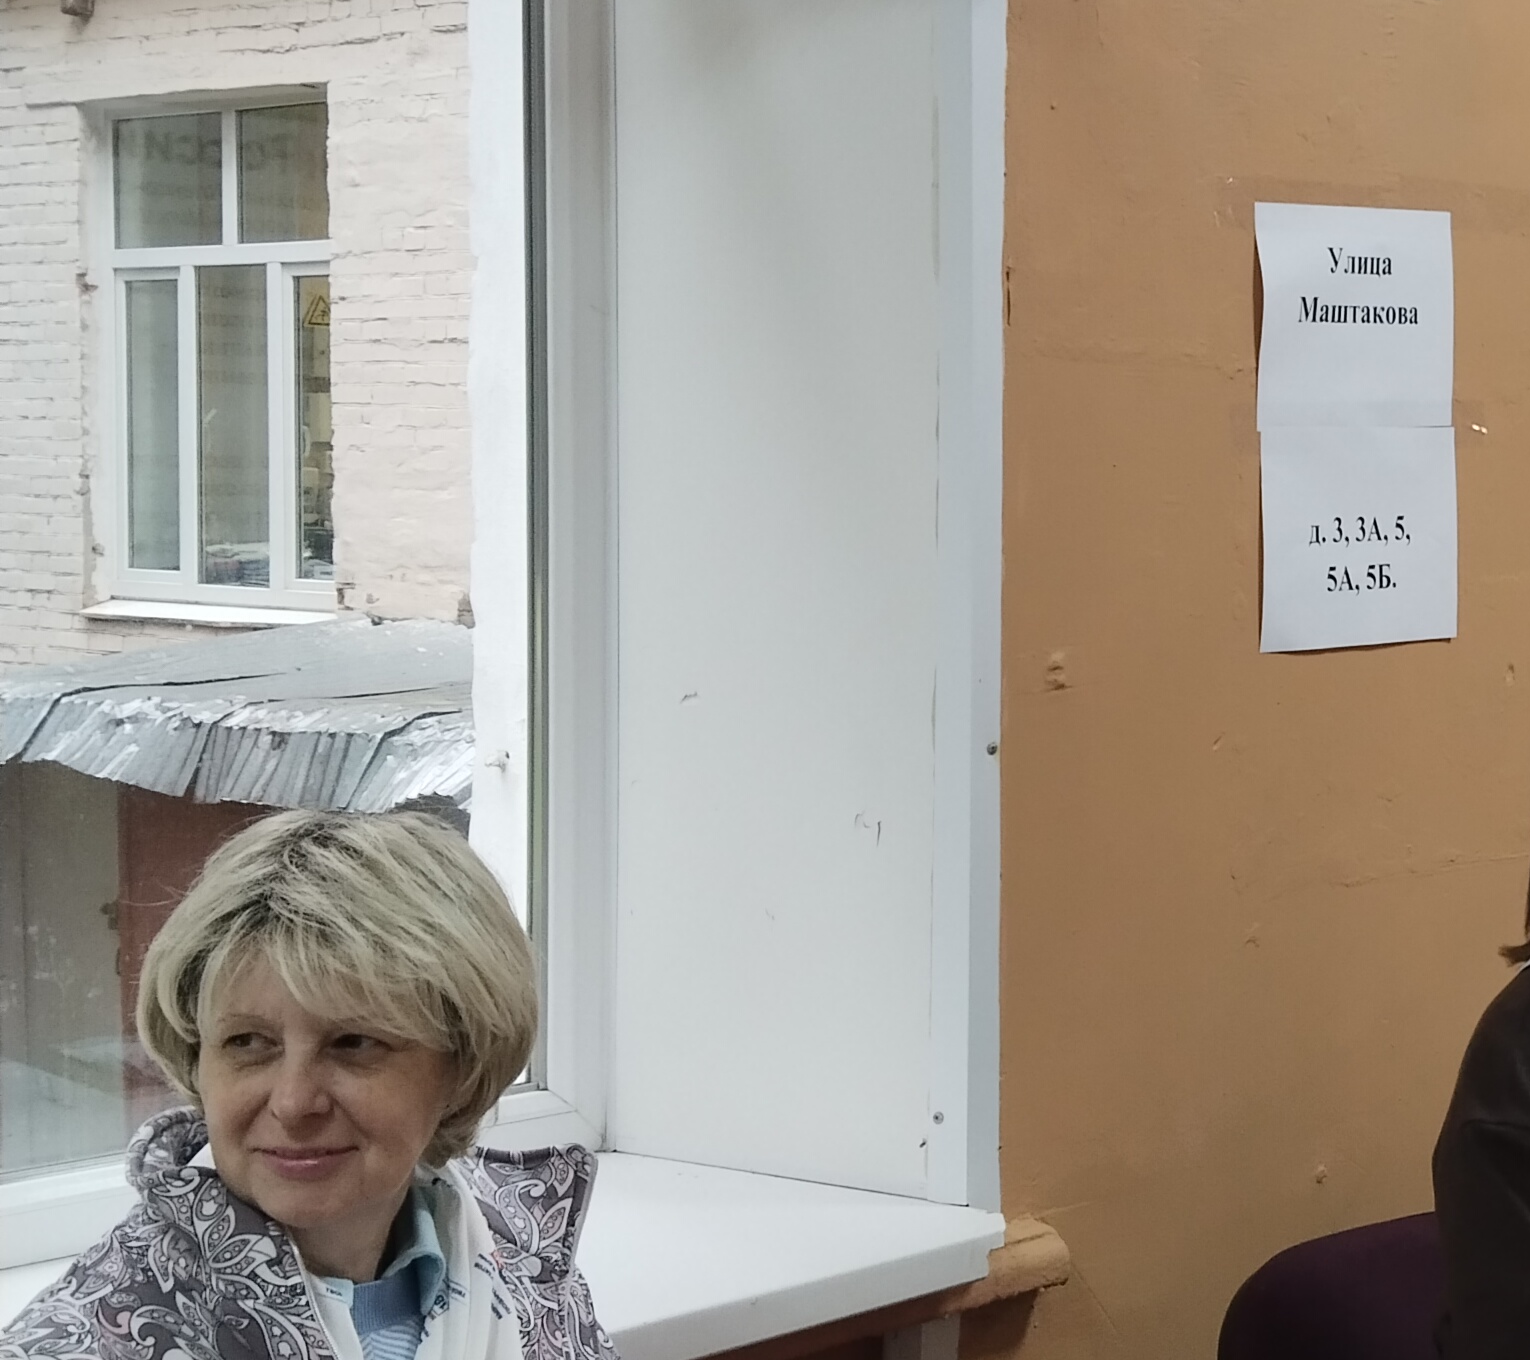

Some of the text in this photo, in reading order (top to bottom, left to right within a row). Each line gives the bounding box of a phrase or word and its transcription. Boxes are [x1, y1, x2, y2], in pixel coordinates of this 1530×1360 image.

[1327, 247, 1392, 277] Улица
[1298, 296, 1418, 325] Маштакова
[1309, 515, 1411, 548] д. 3, 3А, 5,
[1327, 564, 1397, 596] 5А, 5Б.
